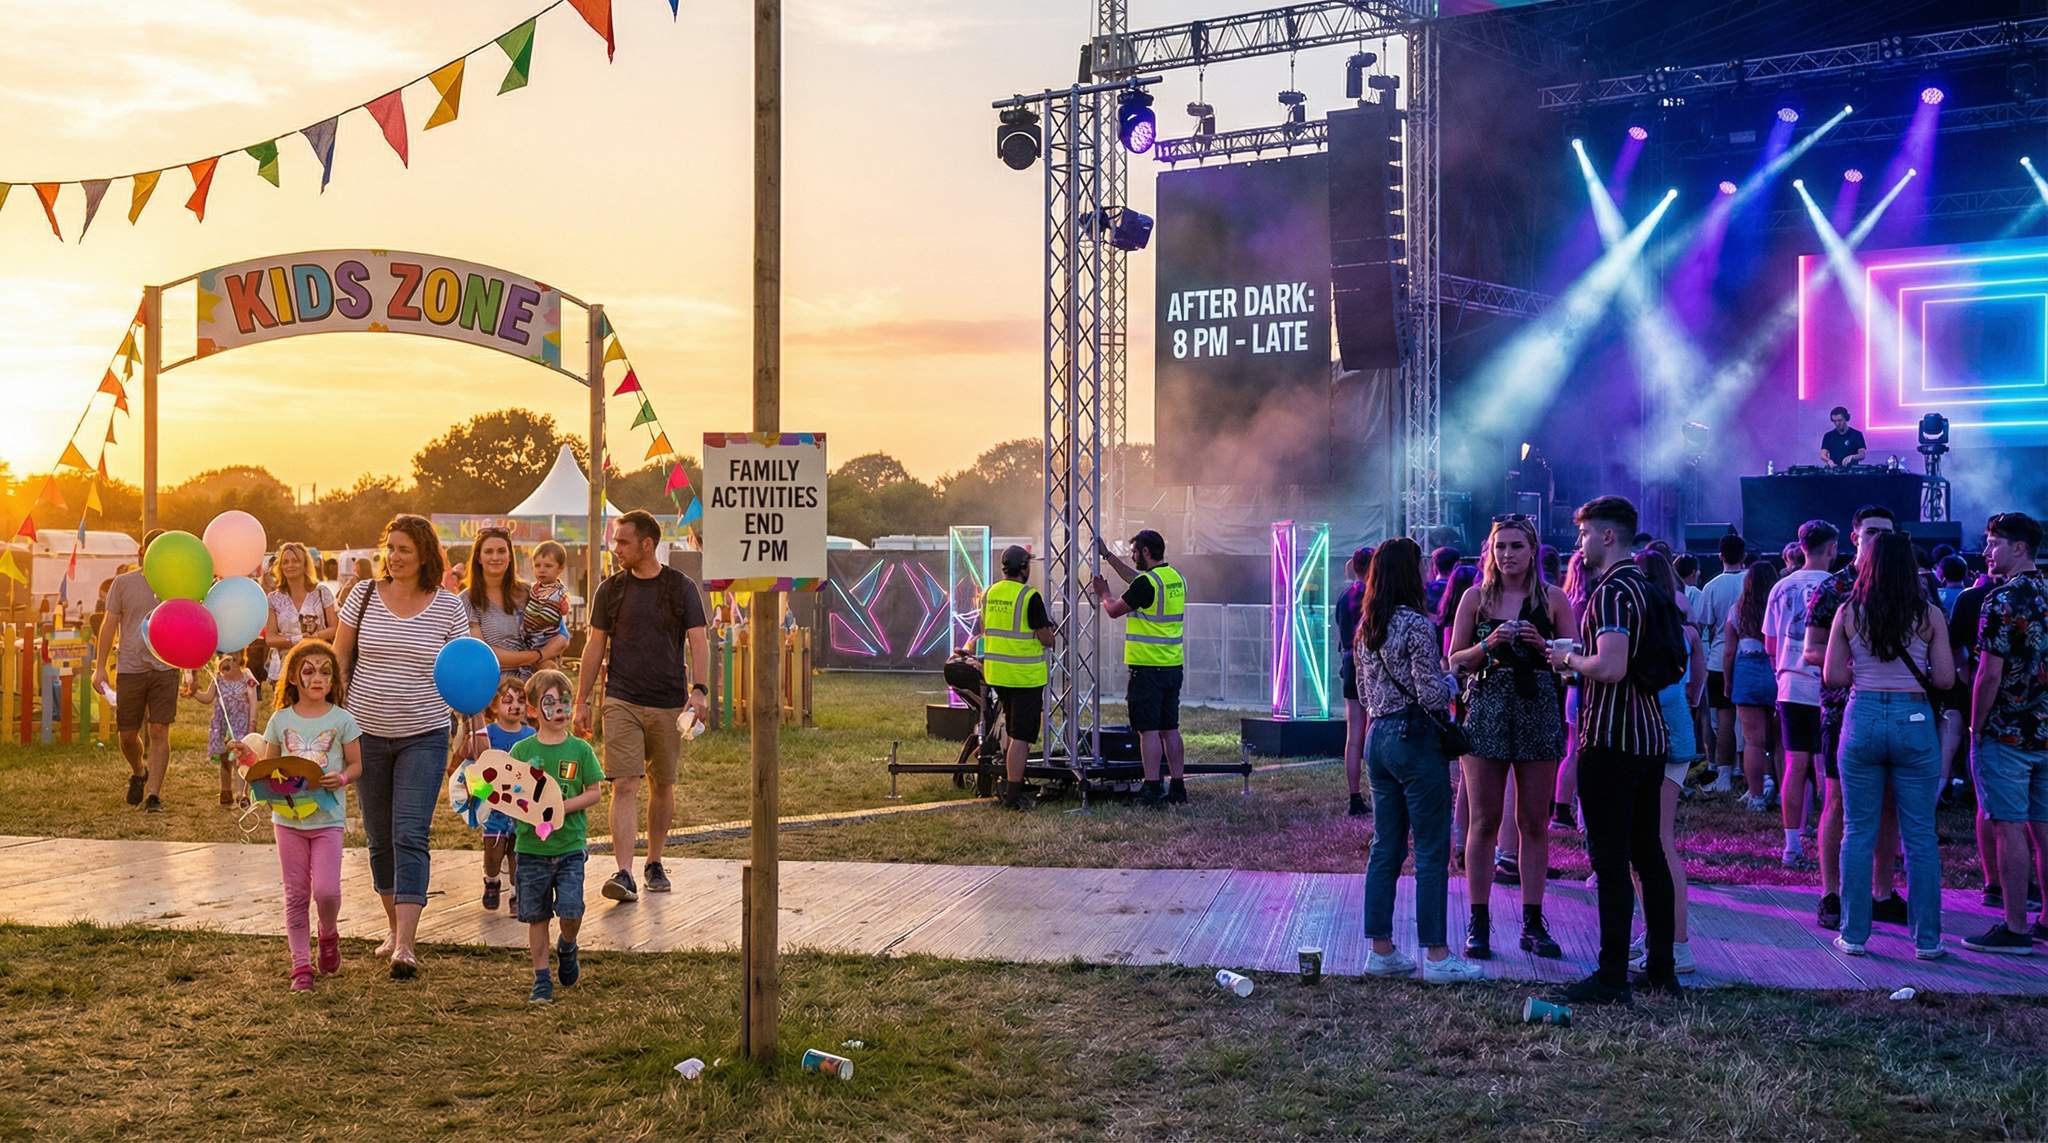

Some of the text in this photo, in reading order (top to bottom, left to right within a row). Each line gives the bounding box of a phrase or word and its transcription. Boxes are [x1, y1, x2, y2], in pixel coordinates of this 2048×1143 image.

[225, 260, 540, 345] KIDS ZONE
[1167, 282, 1314, 321] AFTER DARK:
[1173, 329, 1187, 358] 8
[1194, 326, 1228, 357] PM
[1252, 320, 1308, 353] LATE
[730, 460, 799, 481] FAMILY
[711, 486, 818, 508] ACTIVITIES
[745, 513, 783, 534] END
[740, 540, 787, 561] 7 PM
